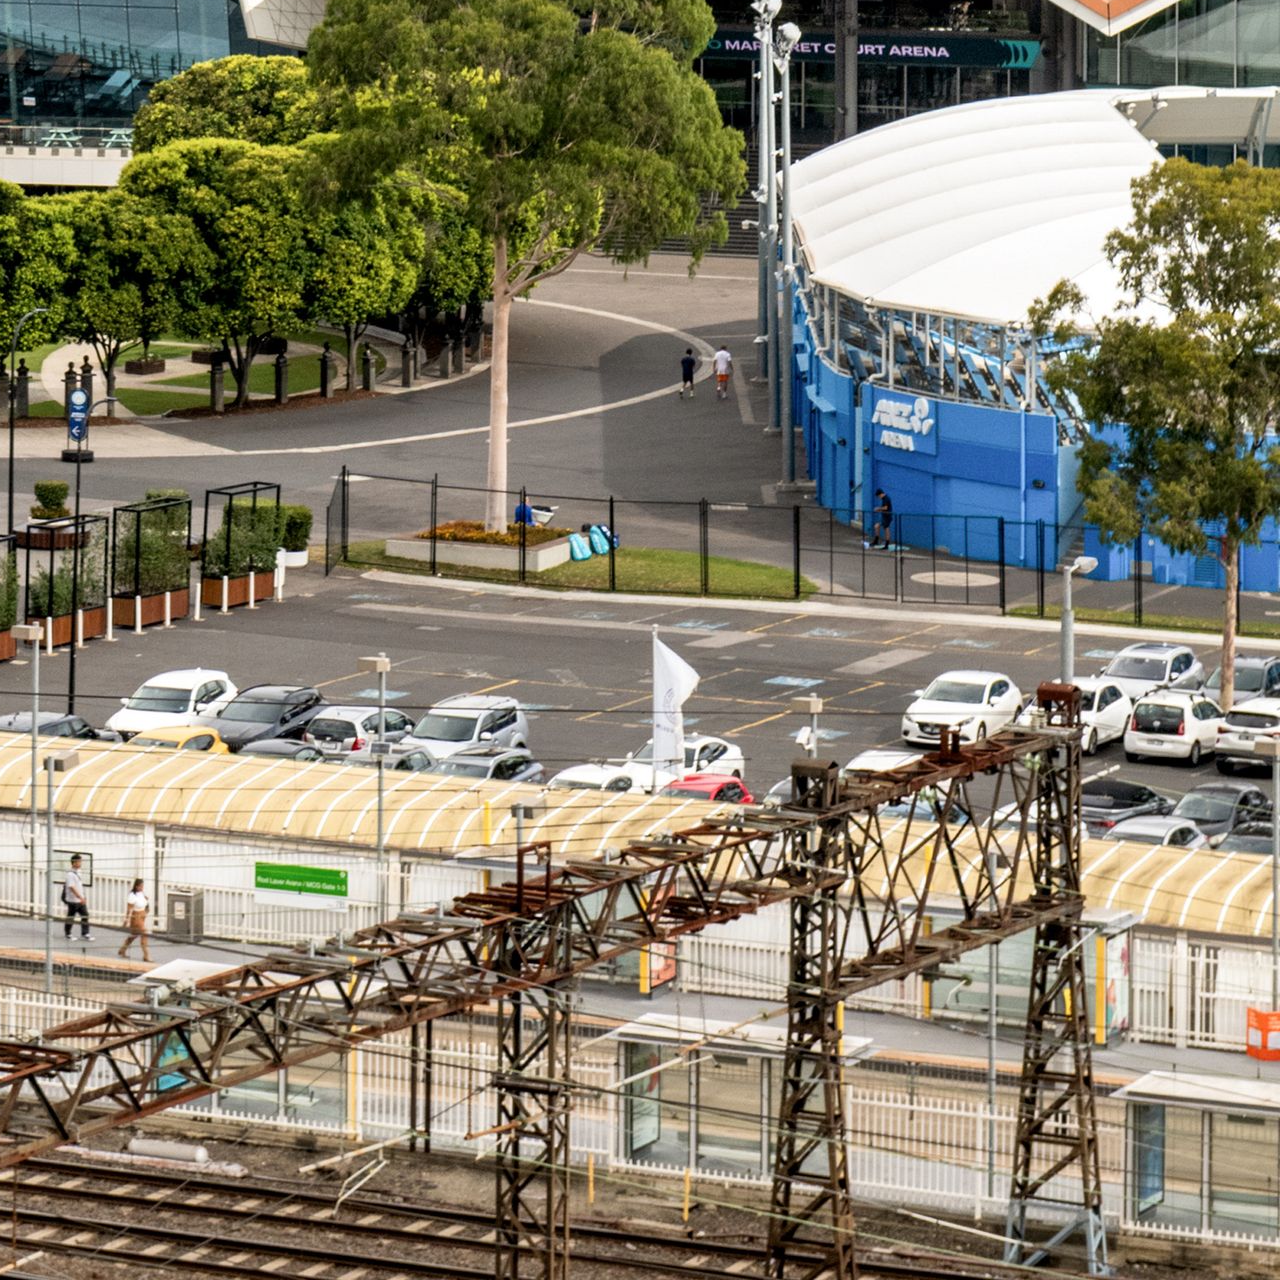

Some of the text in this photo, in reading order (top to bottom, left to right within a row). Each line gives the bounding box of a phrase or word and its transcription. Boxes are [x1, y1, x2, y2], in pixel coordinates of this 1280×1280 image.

[725, 40, 821, 53] MARRET
[825, 42, 885, 56] CURT
[889, 46, 950, 58] ARENA
